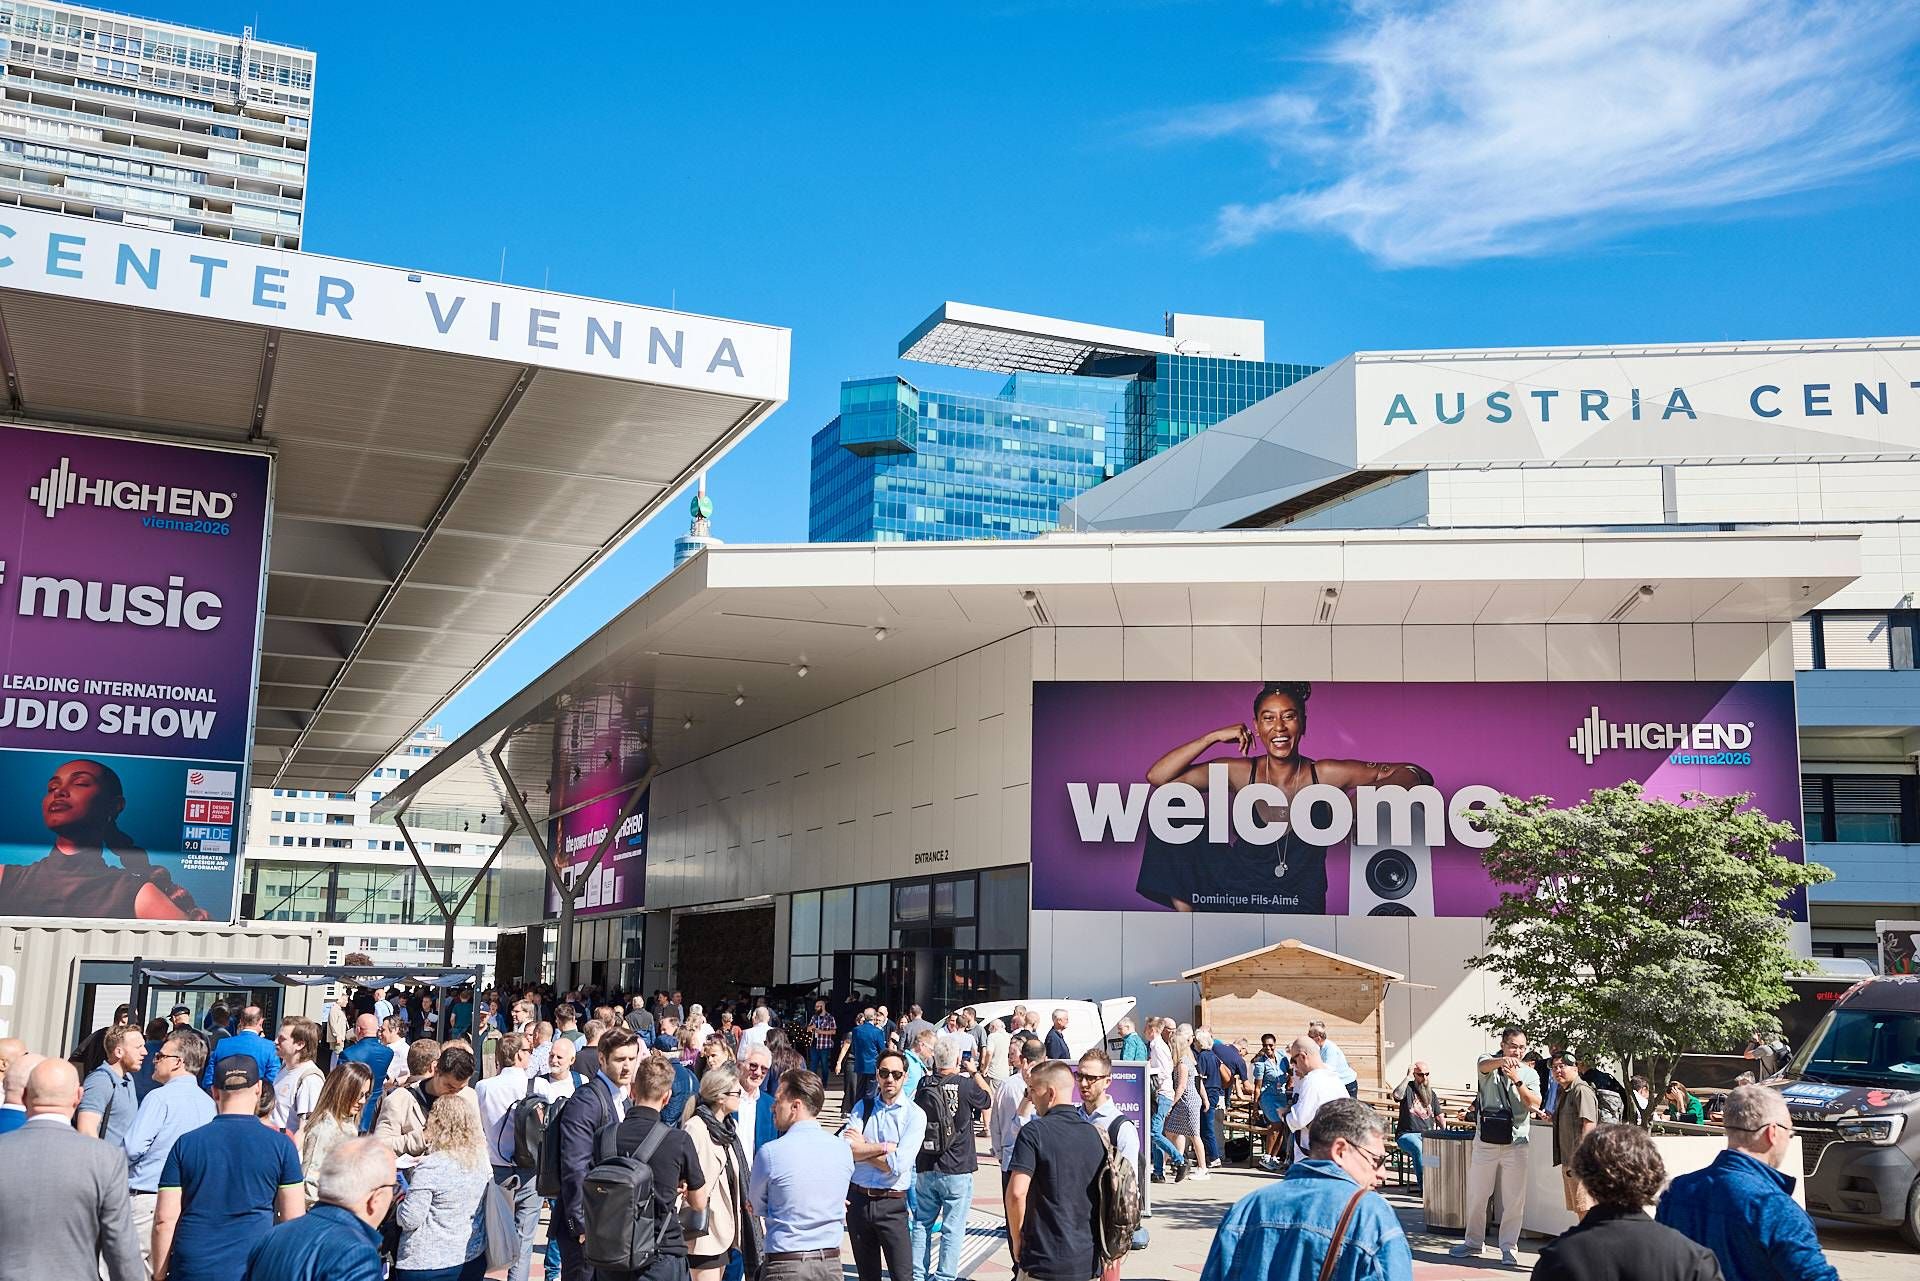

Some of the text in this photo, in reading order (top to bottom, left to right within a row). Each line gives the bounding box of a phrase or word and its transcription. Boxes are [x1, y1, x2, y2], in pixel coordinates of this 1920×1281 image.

[425, 291, 745, 378] VIENNA
[1383, 387, 1698, 425] AUSTRIA
[142, 515, 230, 537] vienna2026
[19, 575, 222, 632] music
[3, 674, 217, 703] LEADING INTERNATIONAL
[97, 703, 217, 741] SHOW
[1669, 752, 1751, 766] vienna2026
[1066, 762, 1508, 849] welcome
[184, 840, 199, 850] 9.0
[185, 826, 229, 840] HIFI.DE
[914, 849, 949, 864] ENTRANCE 2
[1191, 893, 1299, 907] Dominique Fils-Aimé
